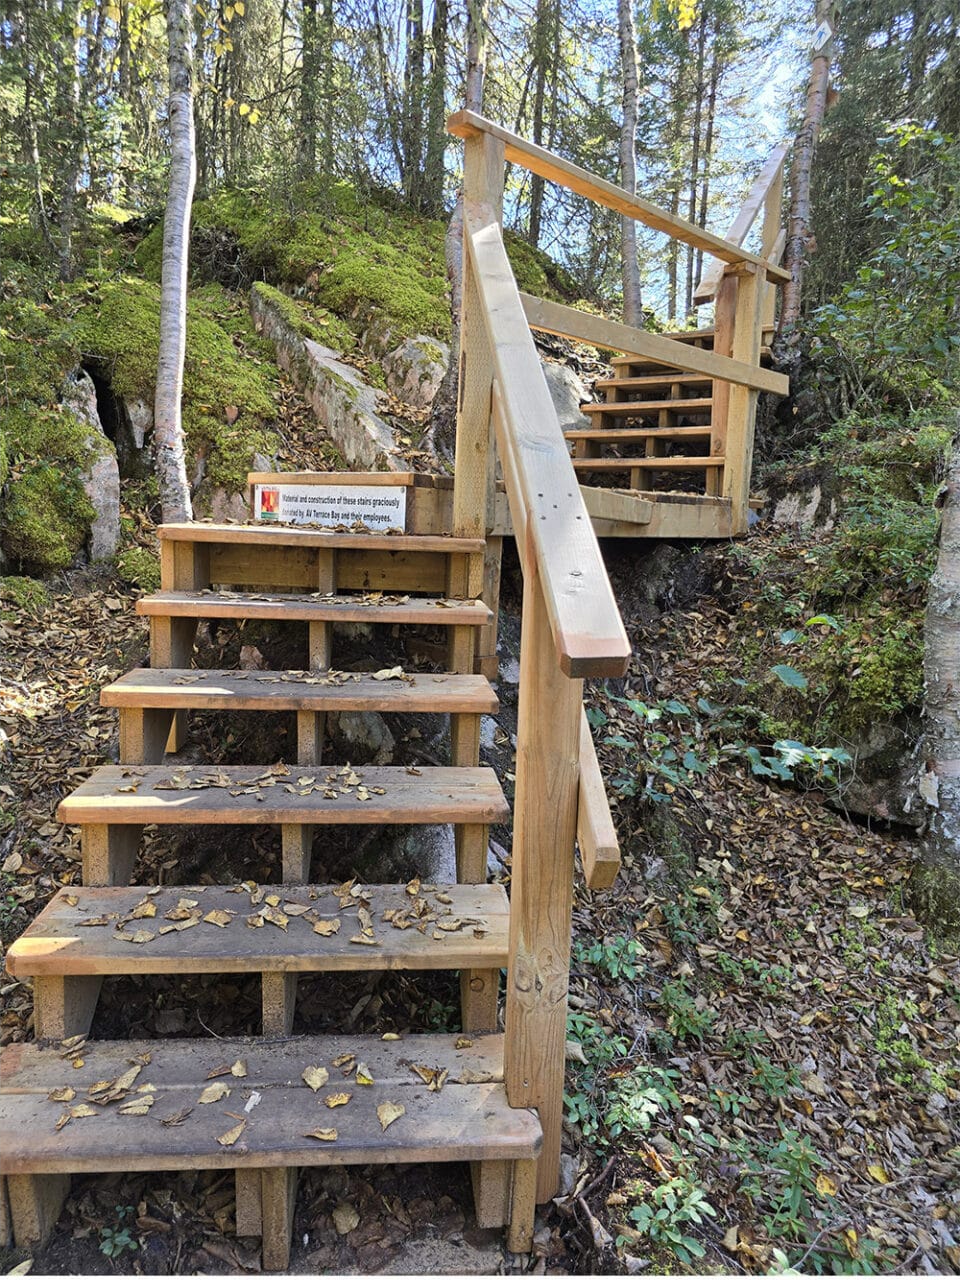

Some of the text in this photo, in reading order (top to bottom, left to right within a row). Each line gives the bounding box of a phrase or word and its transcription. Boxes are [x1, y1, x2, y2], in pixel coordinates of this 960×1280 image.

[308, 495, 336, 504] construction
[343, 496, 356, 505] these
[357, 496, 371, 506] stairs
[372, 497, 400, 508] graciously
[306, 509, 312, 517] AV
[313, 510, 330, 518] Terrace
[331, 510, 340, 520] Bay
[341, 511, 349, 519] and
[351, 511, 362, 520] their
[363, 512, 392, 523] employees.
